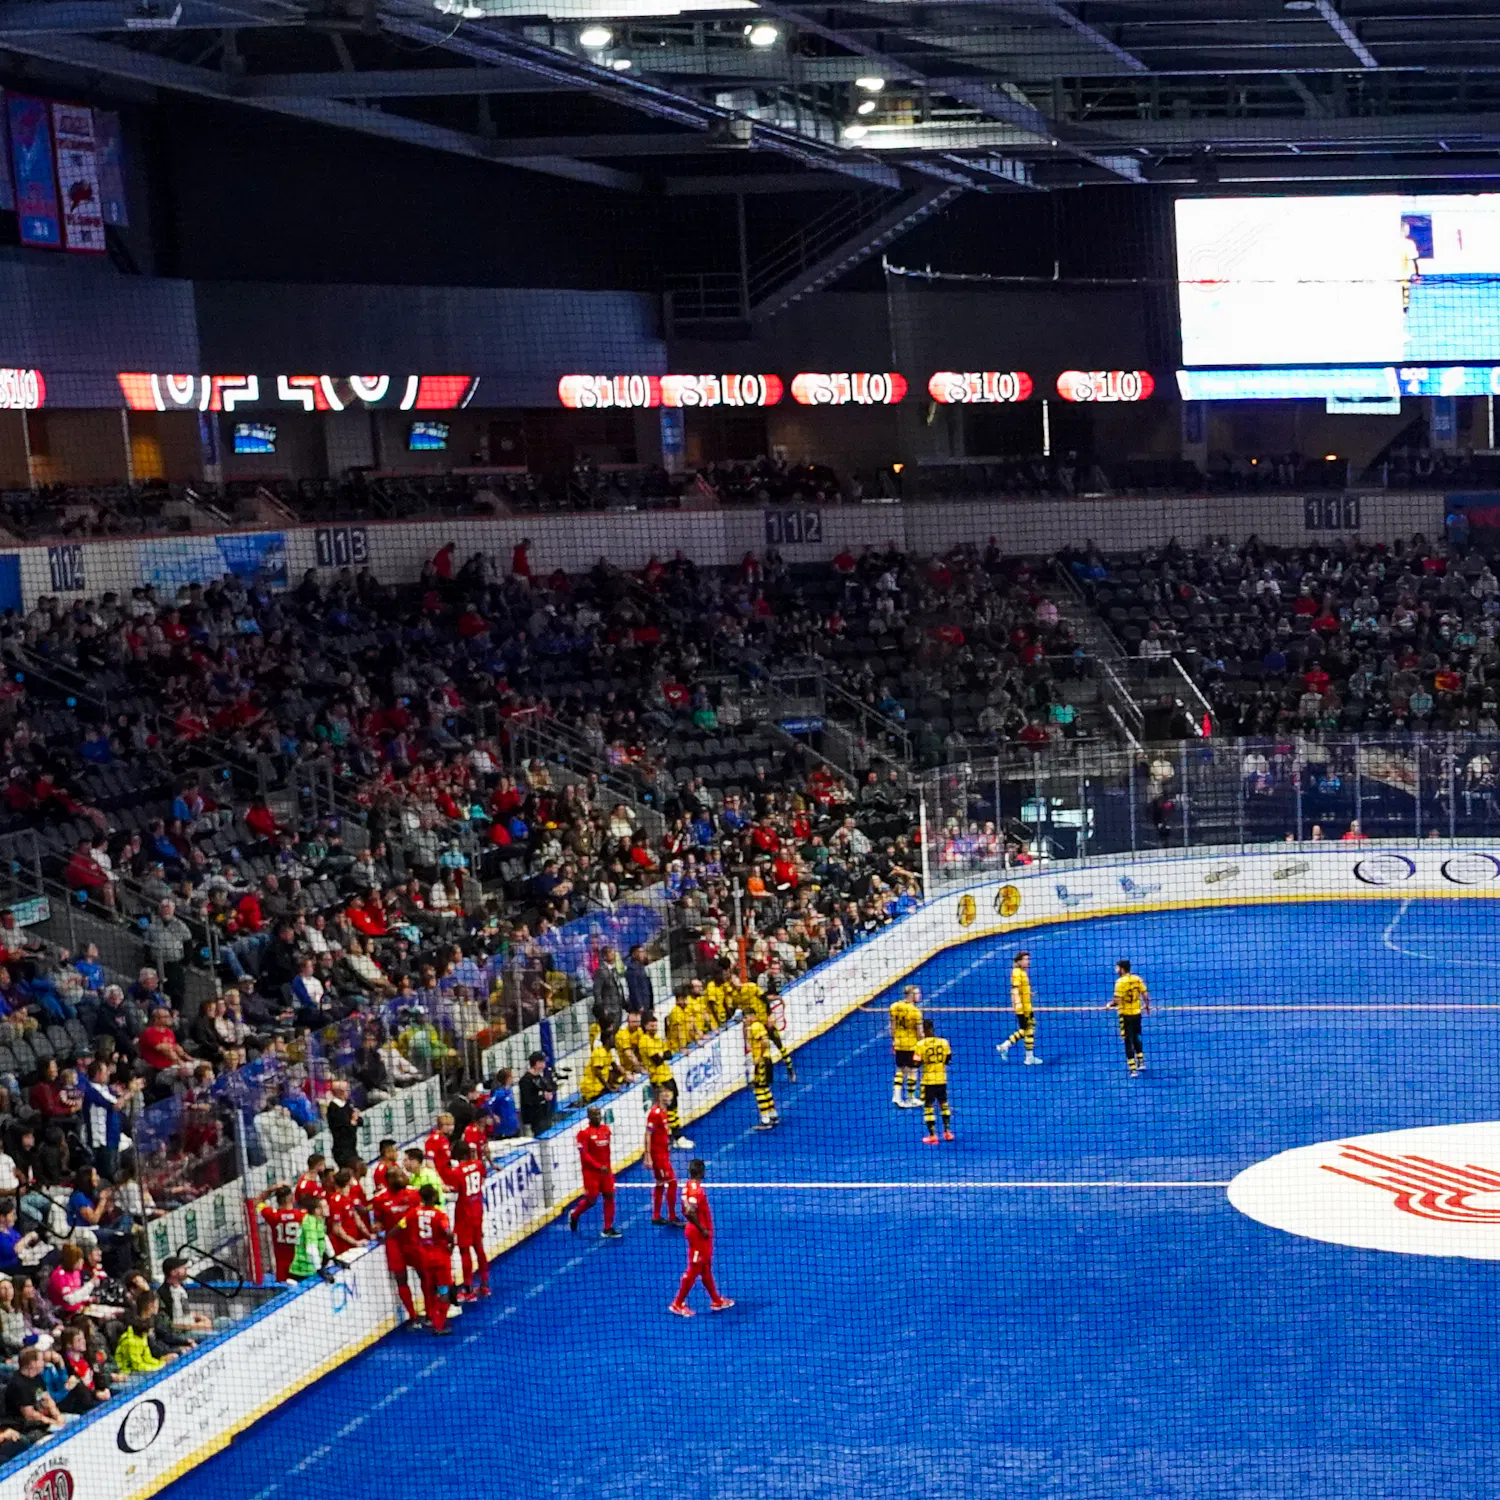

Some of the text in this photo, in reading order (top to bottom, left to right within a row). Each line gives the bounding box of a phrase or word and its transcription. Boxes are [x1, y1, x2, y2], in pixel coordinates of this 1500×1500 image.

[768, 512, 820, 542] 112
[1308, 498, 1360, 529] 111
[318, 530, 368, 562] 113
[465, 1171, 482, 1195] 18
[275, 1221, 300, 1245] 19
[417, 1215, 433, 1239] 5
